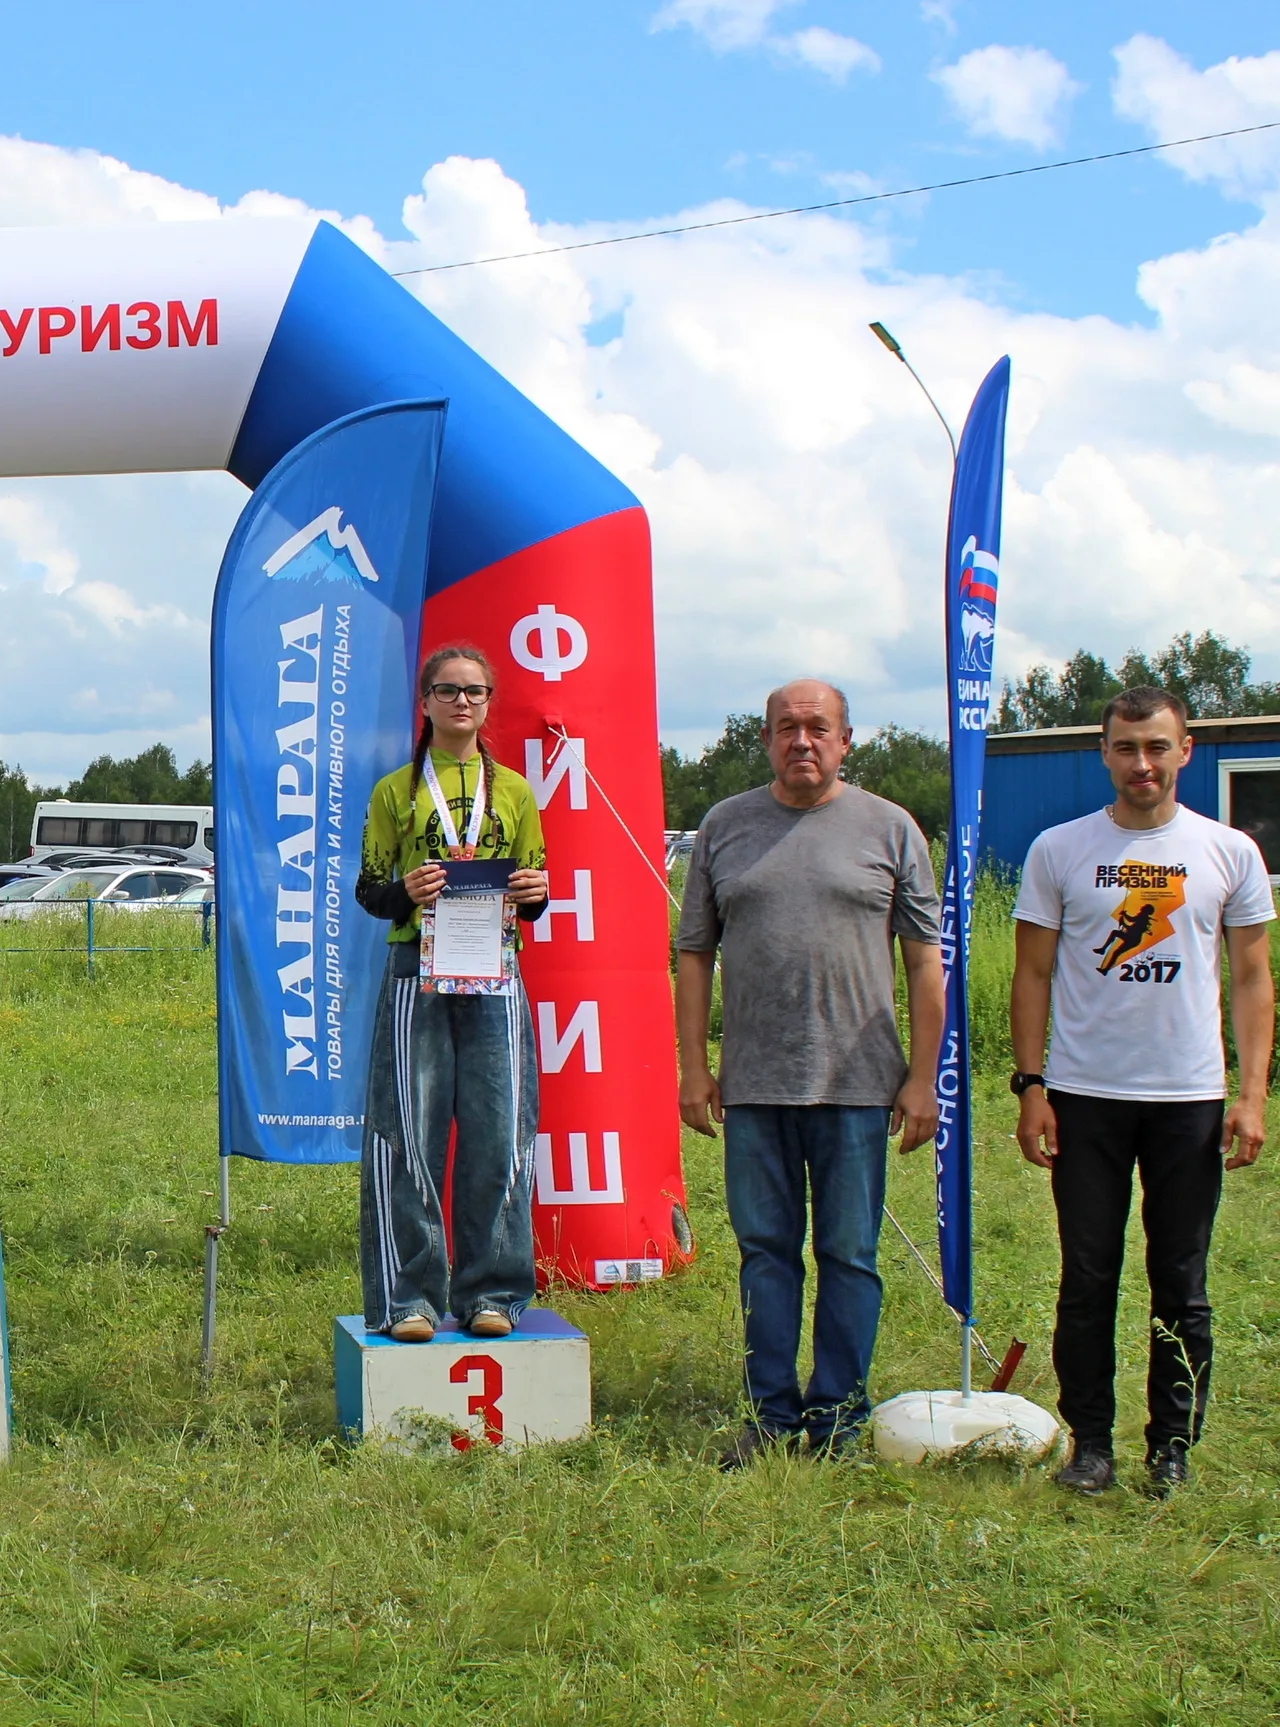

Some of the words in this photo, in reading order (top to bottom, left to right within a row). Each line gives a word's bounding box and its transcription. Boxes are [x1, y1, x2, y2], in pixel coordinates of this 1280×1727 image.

[330, 604, 352, 695] ОТДЫХА
[328, 701, 346, 829] АКТИВНОГО
[274, 602, 324, 1081] МАНАРАГА
[327, 838, 341, 849] И
[1095, 877, 1168, 888] ПРИЗЫВ
[1096, 862, 1187, 878] ВЕСЕННИЙ
[325, 855, 341, 938] СПОРТА
[325, 942, 343, 990] ДЛЯ
[1119, 960, 1181, 983] 2017
[327, 991, 342, 1081] ТОВАРЫ
[449, 1354, 503, 1452] 3
